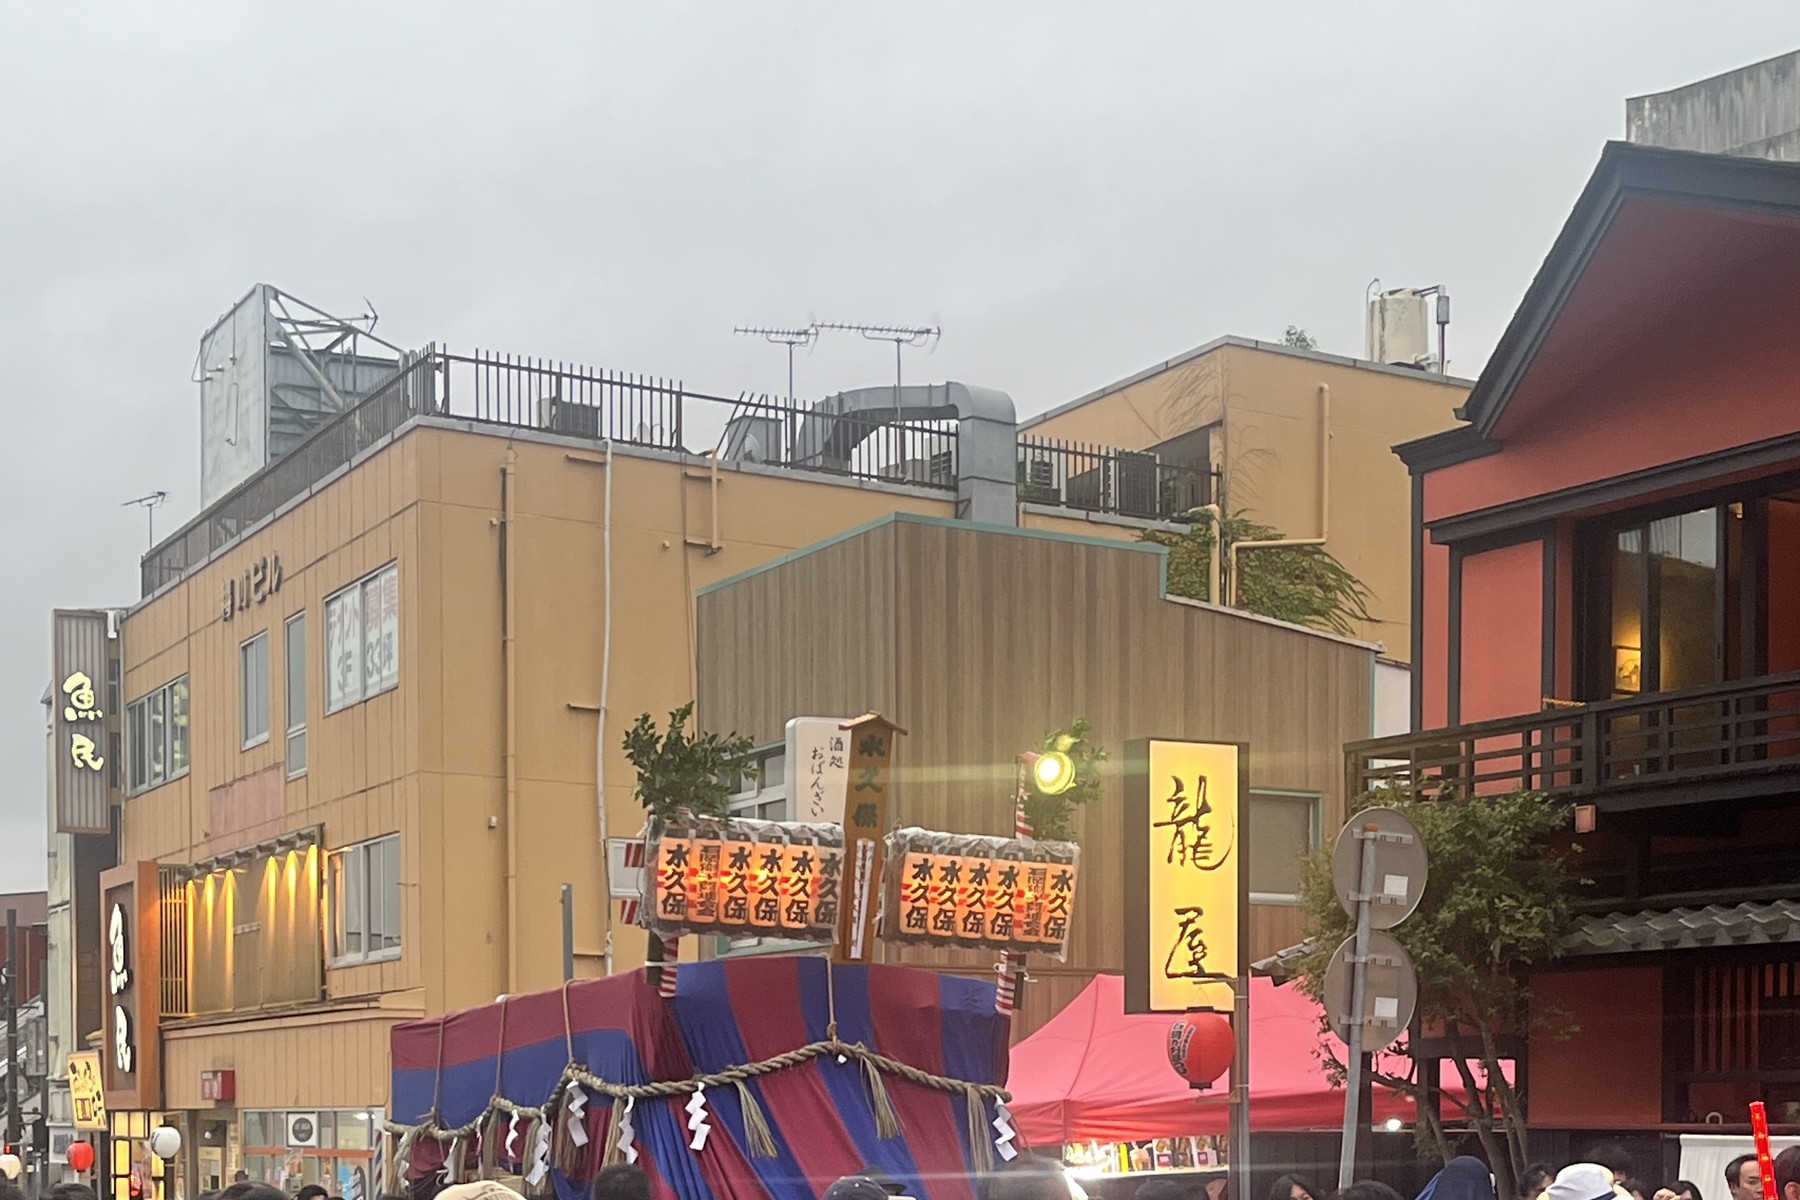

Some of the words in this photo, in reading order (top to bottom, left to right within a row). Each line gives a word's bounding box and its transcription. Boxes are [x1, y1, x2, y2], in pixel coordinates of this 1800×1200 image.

[62, 671, 104, 771] 魚民
[828, 736, 844, 769] 酒処
[810, 746, 825, 817] おばんざい
[851, 733, 886, 828] 水久保
[661, 843, 690, 916] 水久保
[723, 846, 752, 921] 水久保
[754, 848, 784, 923] 水久保
[785, 850, 815, 924] 水久保
[814, 852, 843, 924] 水久保
[906, 857, 935, 929] 水久保
[933, 859, 962, 932] 水久保
[962, 861, 991, 935] 水久保
[990, 864, 1020, 937] 水久保
[1043, 868, 1074, 940] 水久保
[1152, 775, 1235, 979] 龍屋
[109, 902, 132, 1073] 魚民
